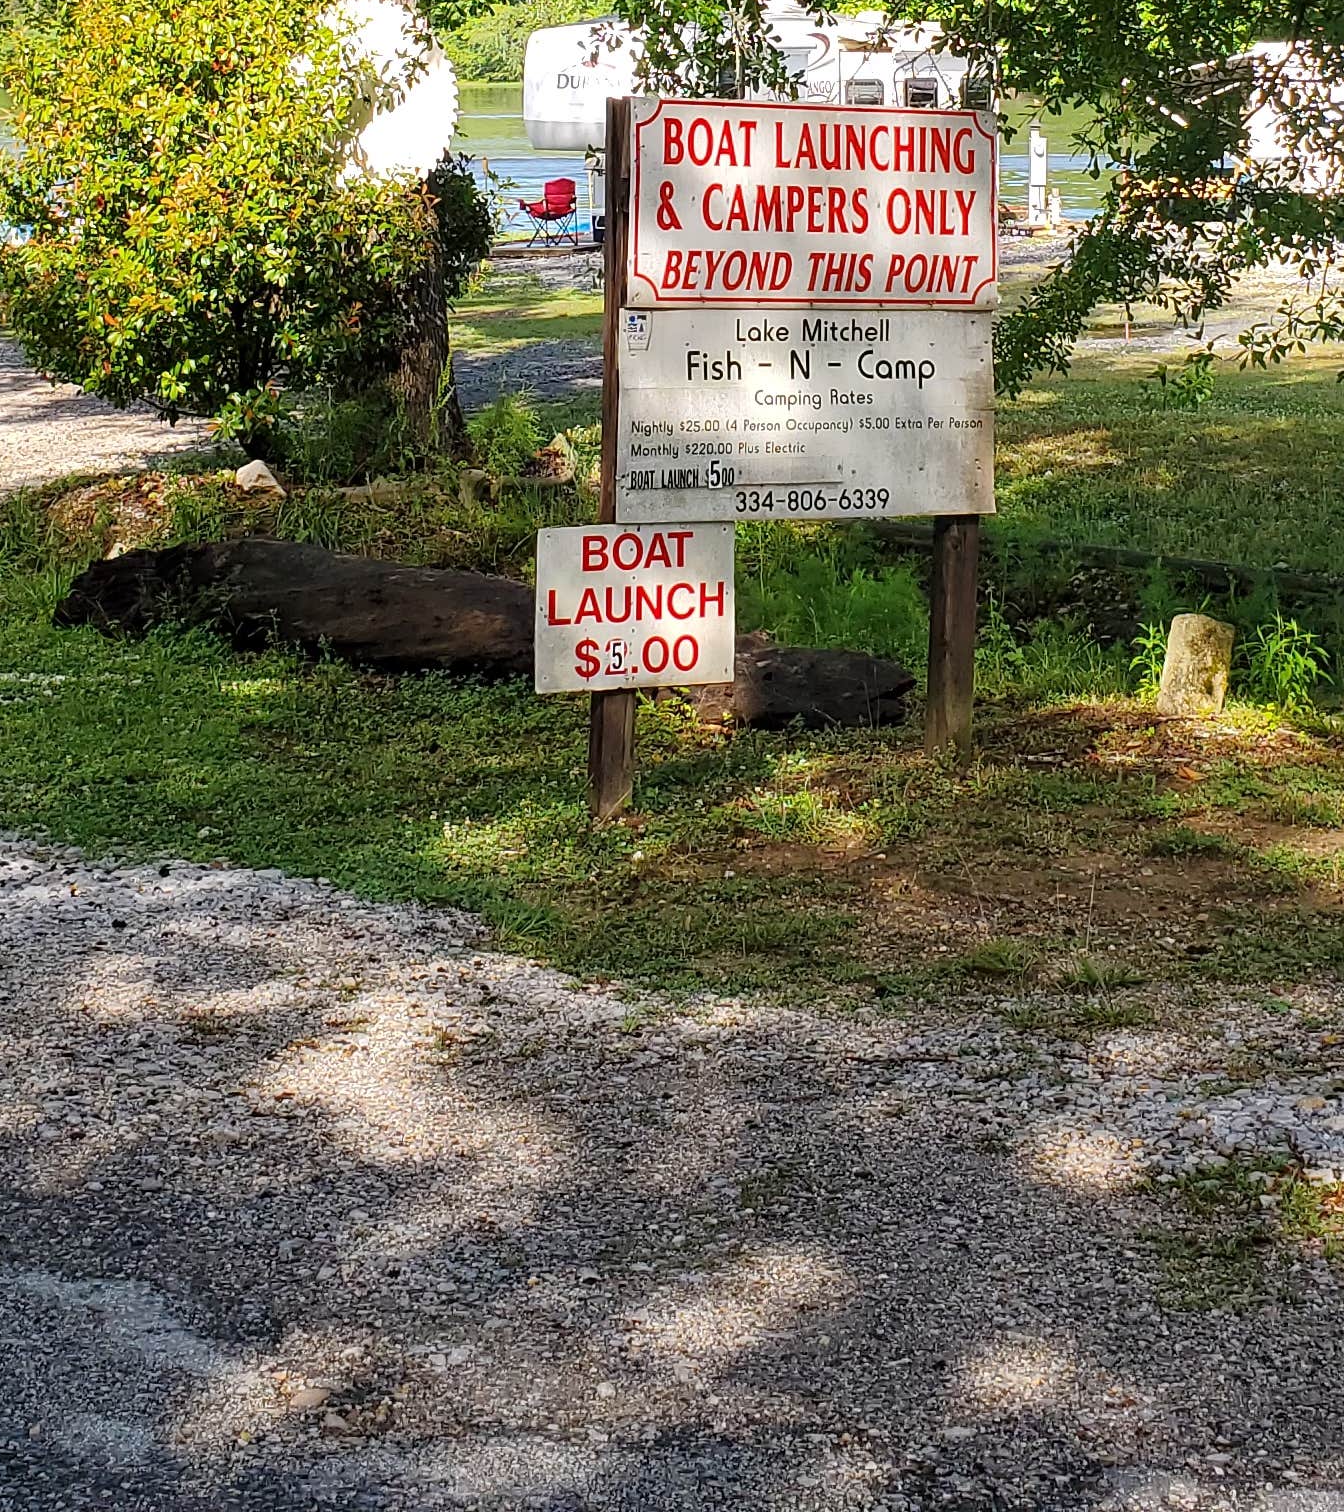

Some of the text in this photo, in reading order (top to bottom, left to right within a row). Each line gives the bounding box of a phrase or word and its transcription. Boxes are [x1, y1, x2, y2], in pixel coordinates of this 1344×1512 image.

[663, 117, 975, 175] BOAT LAUNCHING
[657, 180, 977, 236] & CAMPERS ONLY
[661, 250, 979, 294] BEYOND THIS POINT
[736, 318, 889, 342] Lake Mitchell
[687, 350, 742, 381] Fish
[790, 349, 810, 379] N
[857, 349, 935, 389] Camp
[755, 389, 874, 410] Camping Rates
[631, 417, 983, 437] Nightly $25.00 (4 Person Occupancy) $5.00 Extra Per Person
[631, 441, 806, 459] Monthly $220.00 Plus Electric
[630, 470, 655, 489] BOAT
[661, 468, 699, 489] LAUNCH
[735, 488, 890, 512] 334-806-6339
[582, 532, 694, 572] BOAT
[547, 582, 725, 626] LAUNCH
